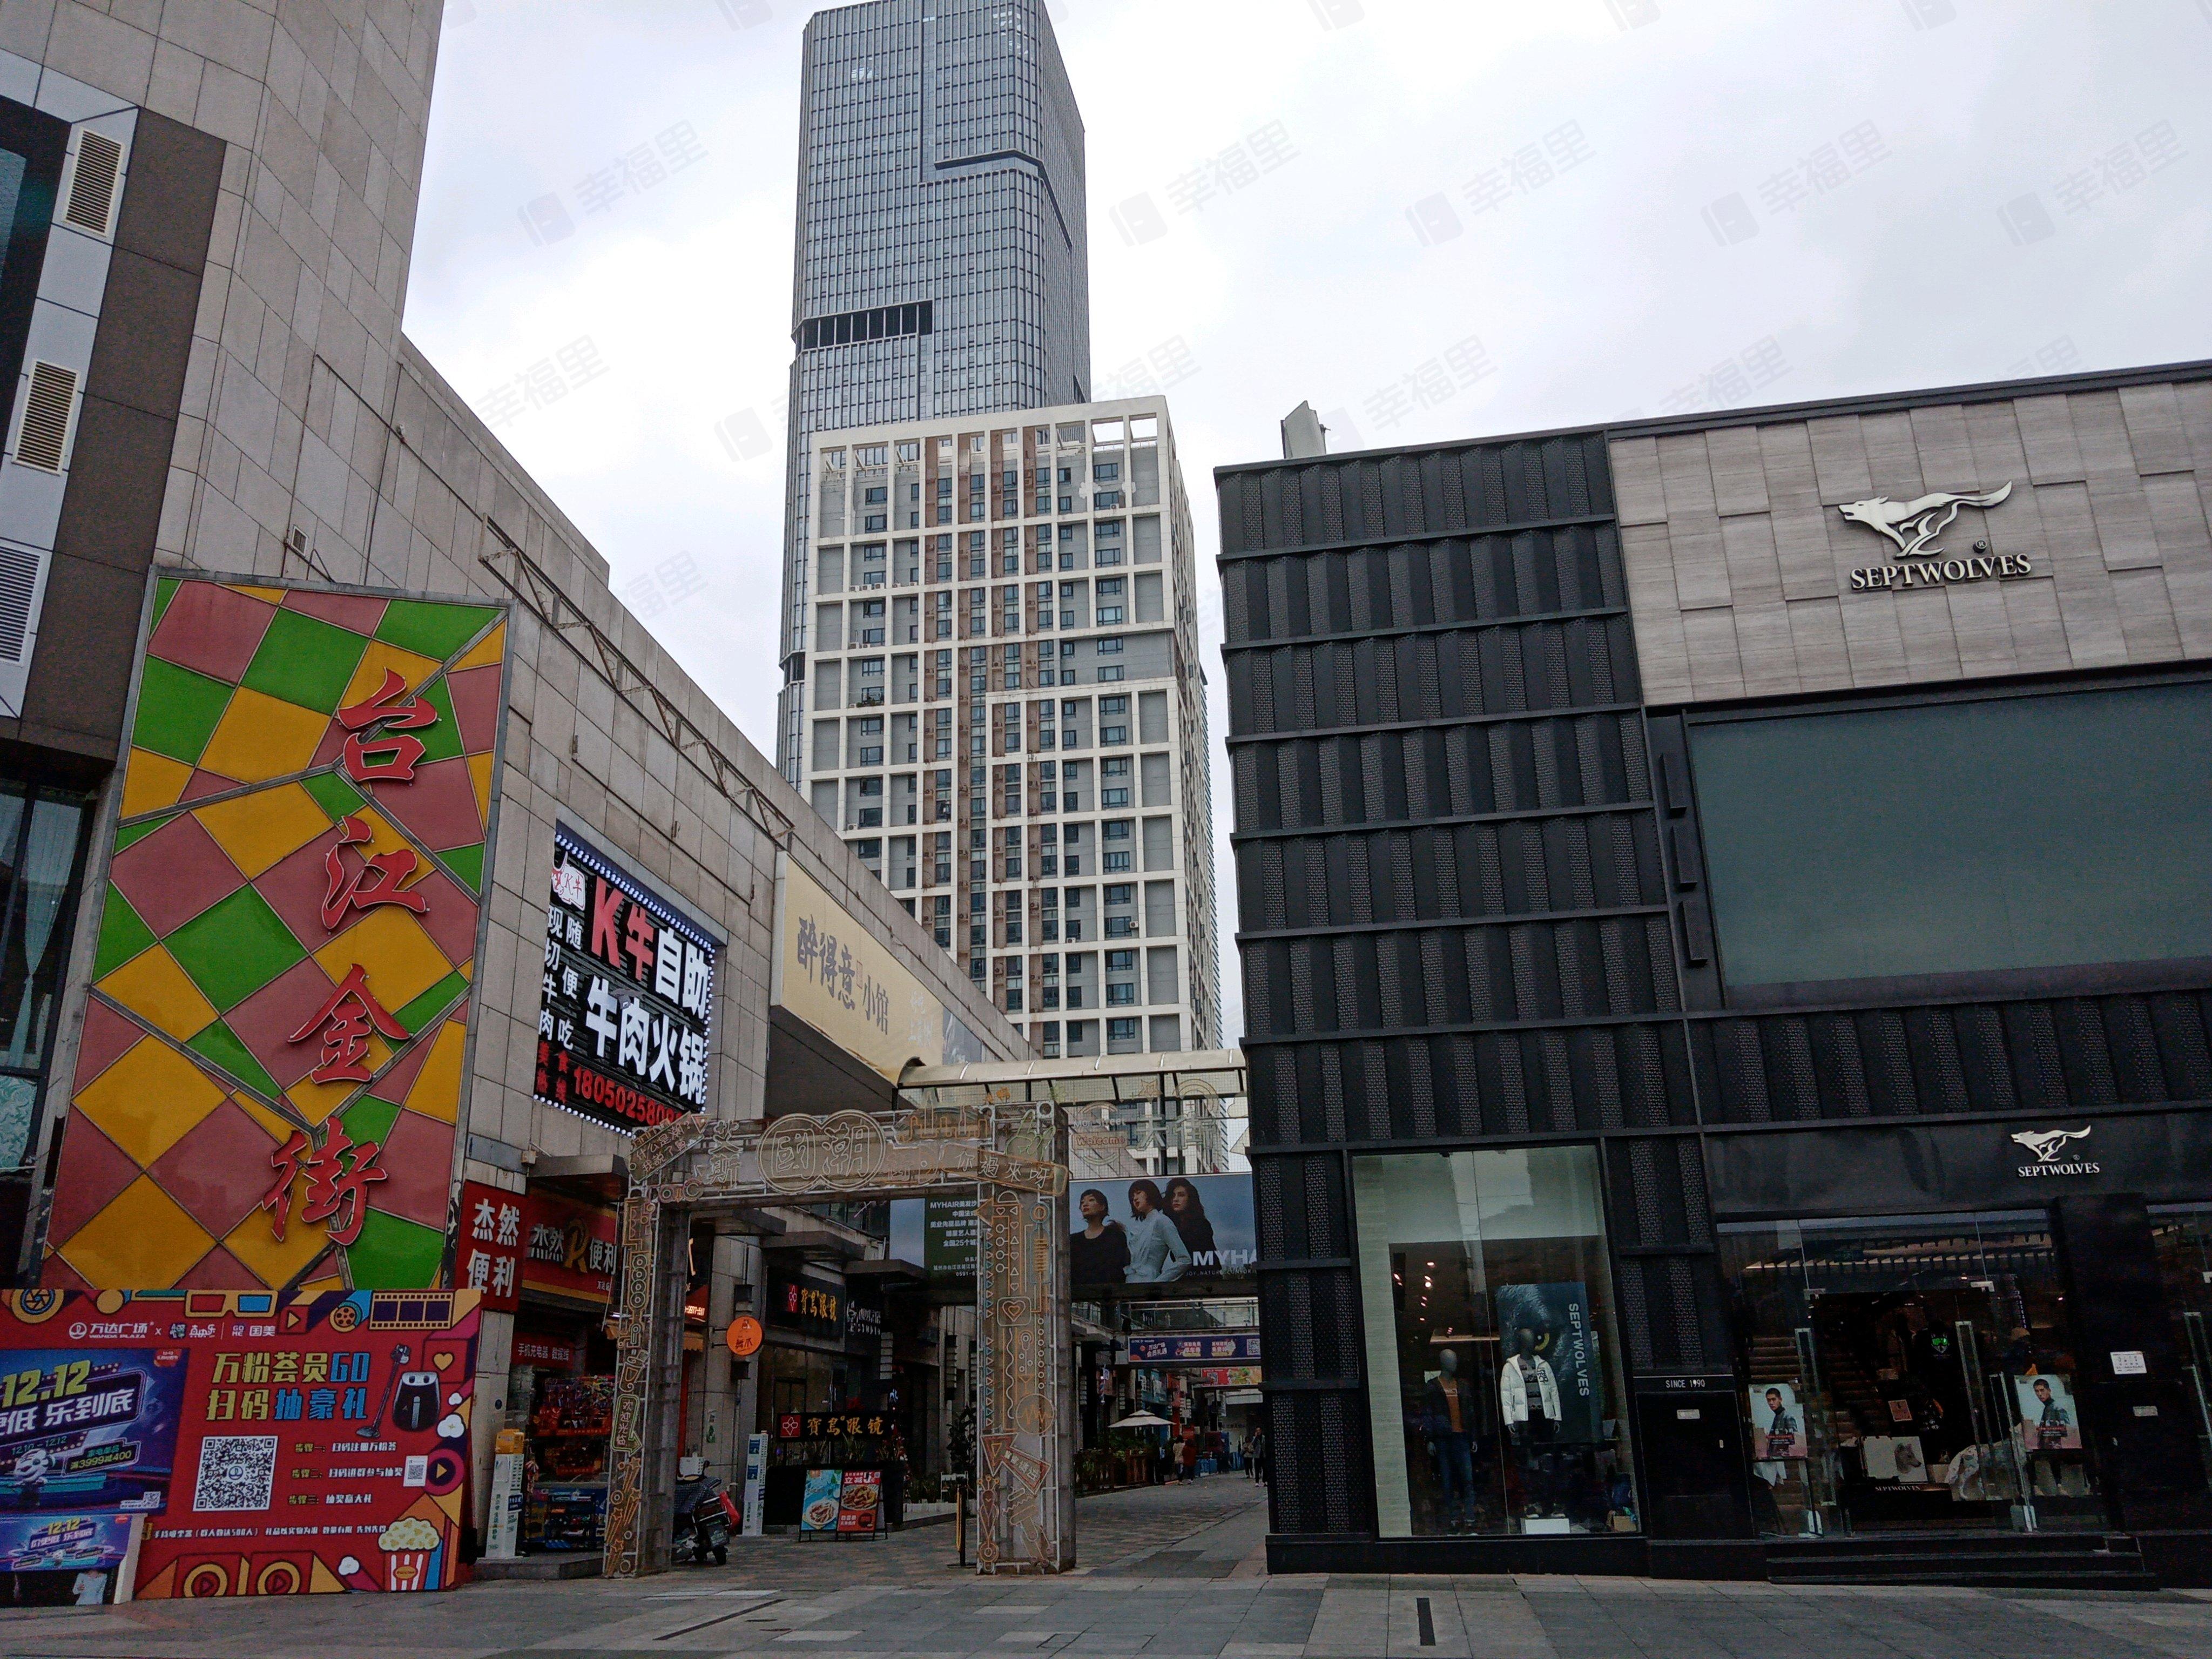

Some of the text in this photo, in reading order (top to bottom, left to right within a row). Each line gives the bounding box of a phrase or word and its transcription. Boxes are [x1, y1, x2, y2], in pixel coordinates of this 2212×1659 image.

[1850, 554, 2032, 590] SEPTWOLVES
[262, 667, 436, 1246] 台江金街
[591, 875, 709, 1019] K牛自助
[538, 906, 563, 1041] 现切牛肉
[557, 916, 583, 1050] 随便吃
[586, 976, 705, 1104] 牛肉火锅
[574, 1065, 683, 1126] 180502580
[772, 1122, 869, 1179] 國潮
[1076, 1135, 1126, 1145] Welcome
[956, 1151, 1049, 1189] 你過來呀
[2018, 1162, 2100, 1178] SEPTWOLVES
[471, 1198, 520, 1247] 杰然
[943, 1239, 977, 1247] 全国25个城
[466, 1247, 516, 1298] 便利
[90, 1323, 148, 1334] 万达广场
[249, 1325, 276, 1337] 国美
[1568, 1303, 1590, 1397] SEPTWOLVES
[1, 1359, 91, 1408] 12.12
[44, 1388, 135, 1427] 乐到底
[206, 1387, 368, 1421] 扫码抽豪礼
[1665, 1379, 1706, 1388] SINCE 1990
